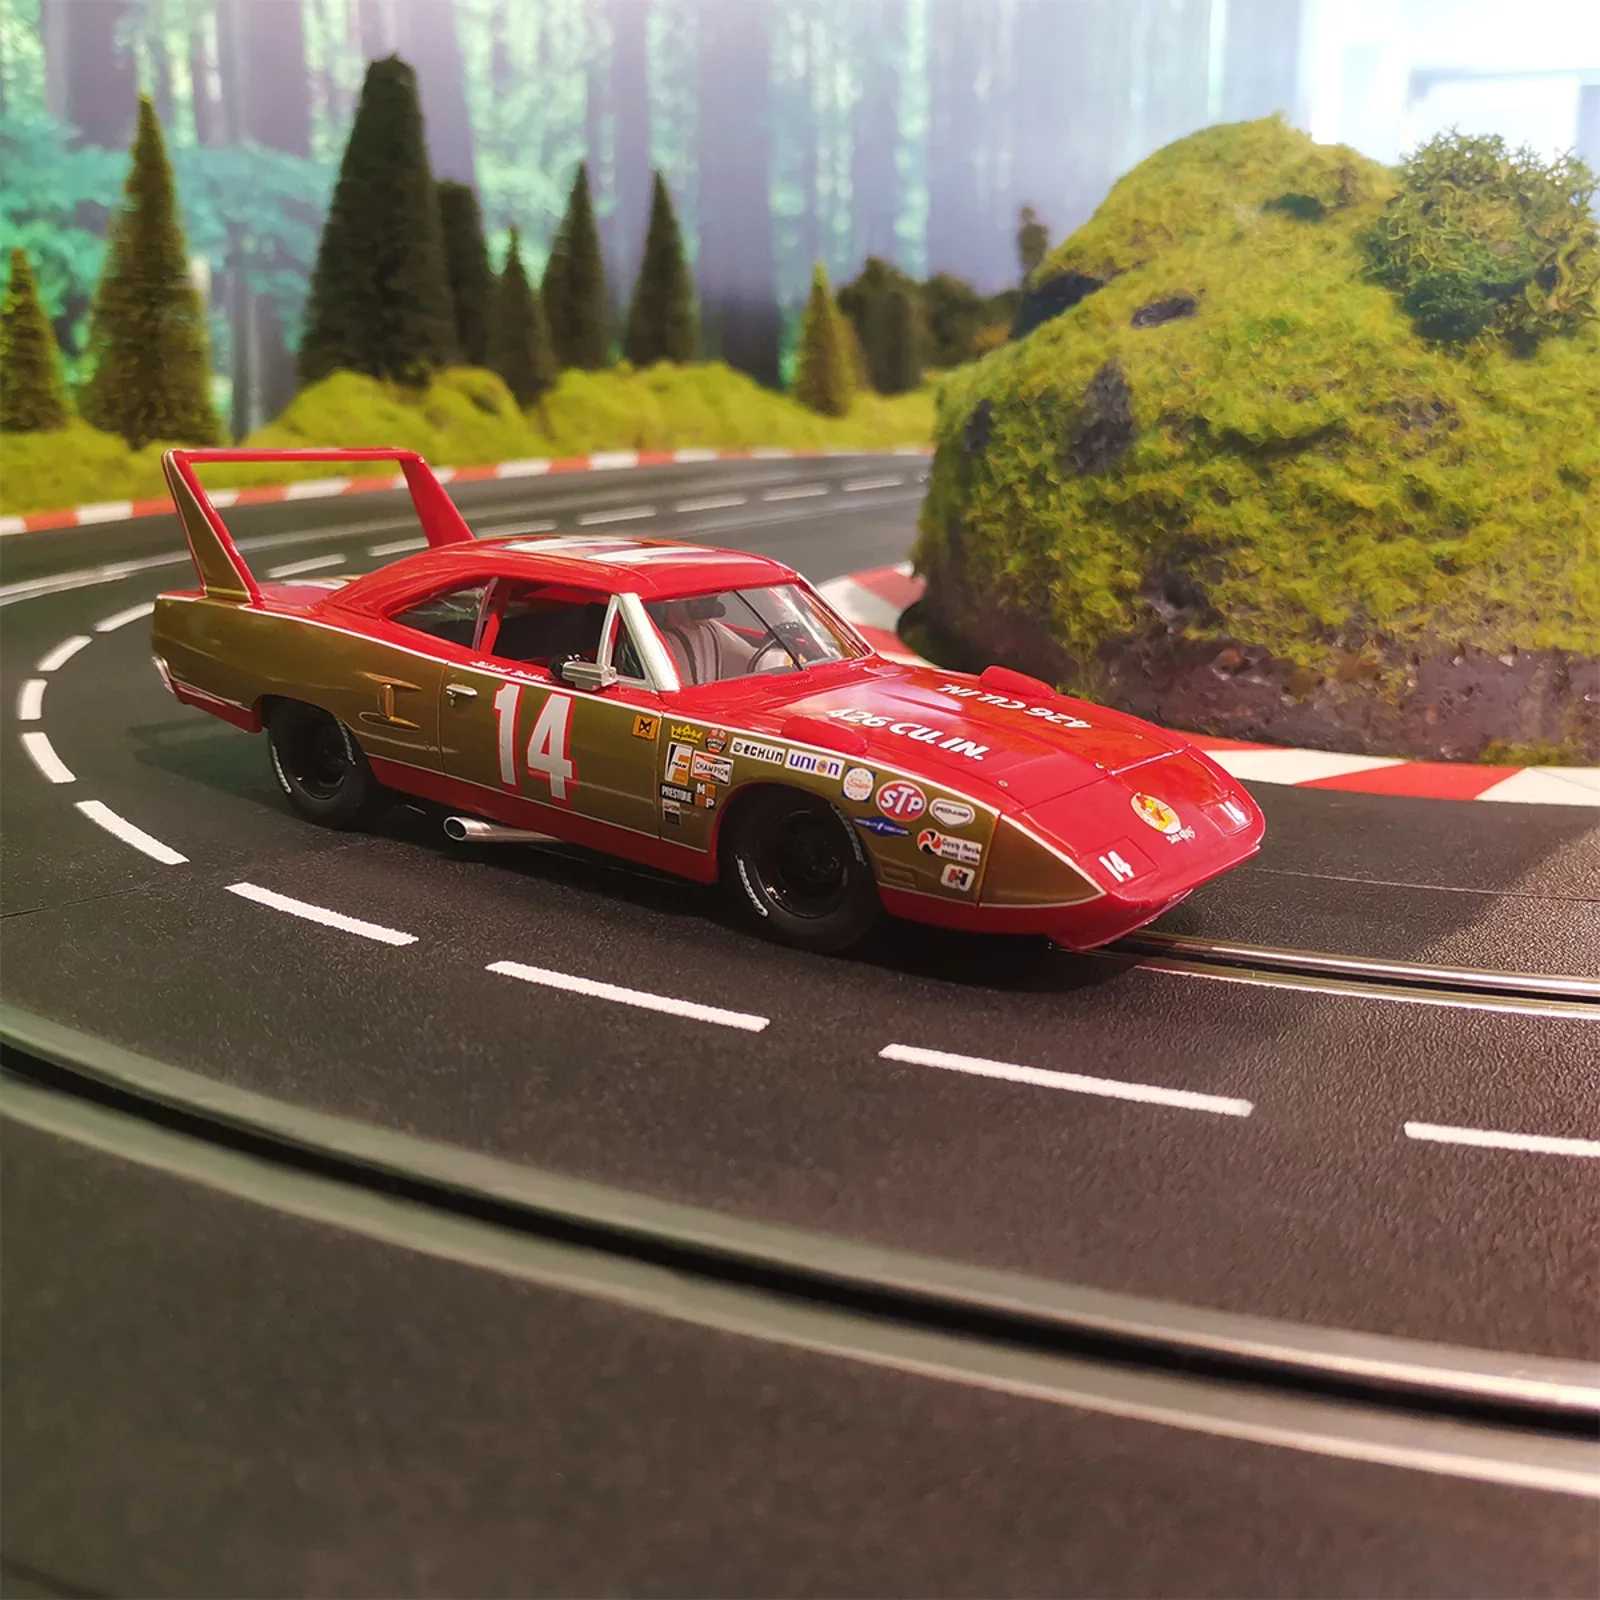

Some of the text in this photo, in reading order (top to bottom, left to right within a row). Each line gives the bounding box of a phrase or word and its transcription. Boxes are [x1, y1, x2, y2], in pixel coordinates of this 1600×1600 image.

[1023, 703, 1093, 729] 426
[493, 681, 577, 804] 14
[825, 707, 990, 761] 426 CU. IN.
[695, 761, 729, 777] CHAMPION
[880, 785, 924, 815] STP
[1098, 850, 1136, 883] 14
